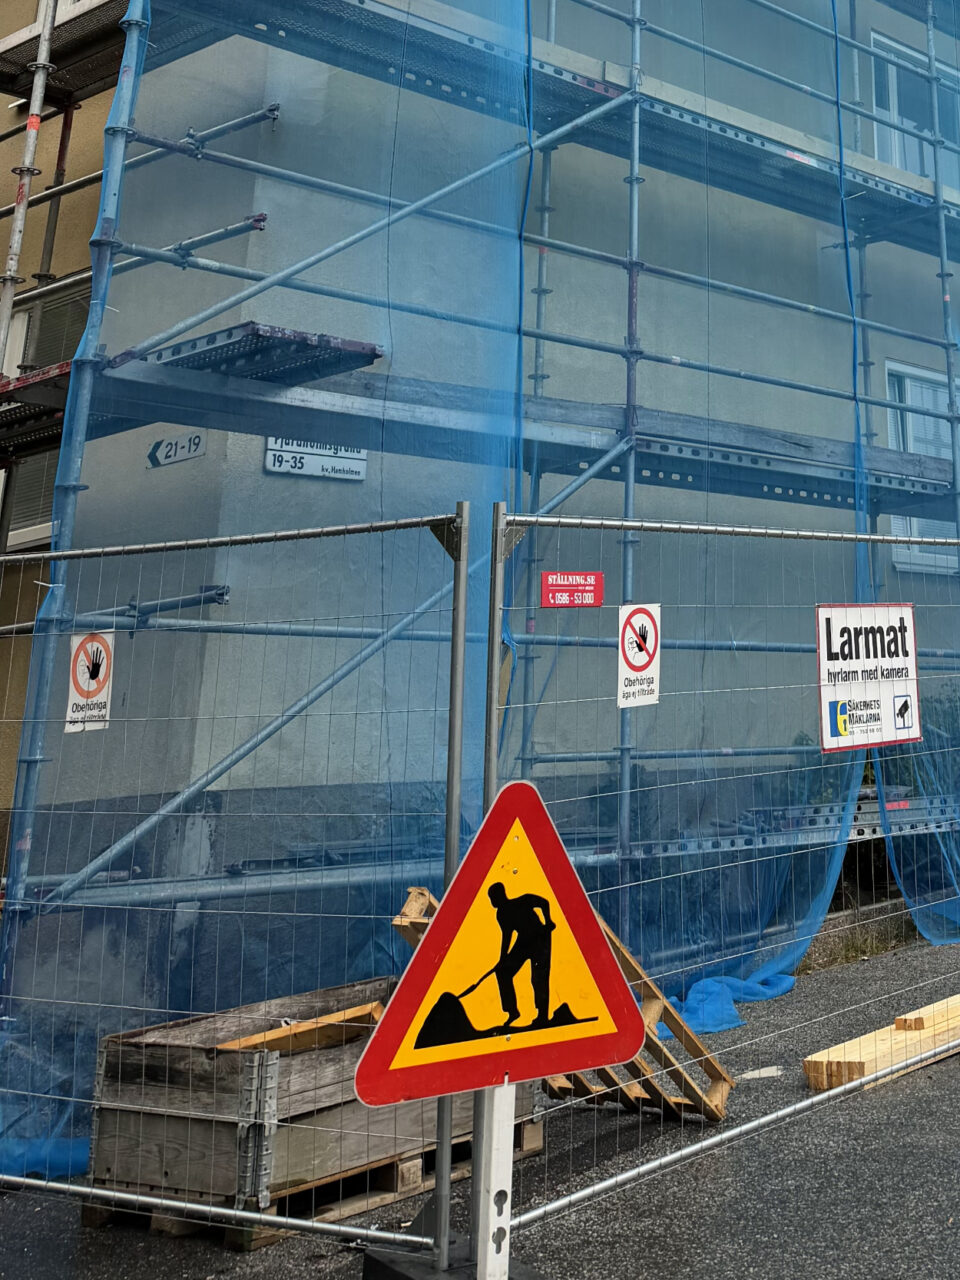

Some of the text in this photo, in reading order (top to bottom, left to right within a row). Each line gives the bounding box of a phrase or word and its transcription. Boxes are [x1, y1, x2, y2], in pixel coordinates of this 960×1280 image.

[164, 435, 201, 460] 21-19
[272, 453, 305, 470] 19-35
[574, 592, 582, 604] 53
[582, 592, 594, 604] 000
[825, 617, 909, 661] Larmat
[624, 675, 654, 688] Obehöriga
[827, 665, 909, 686] hyrlarm med kamera
[72, 701, 106, 713] Obehöriga
[848, 699, 880, 712] SÄKERHETS
[848, 712, 880, 725] MÄKLARNA
